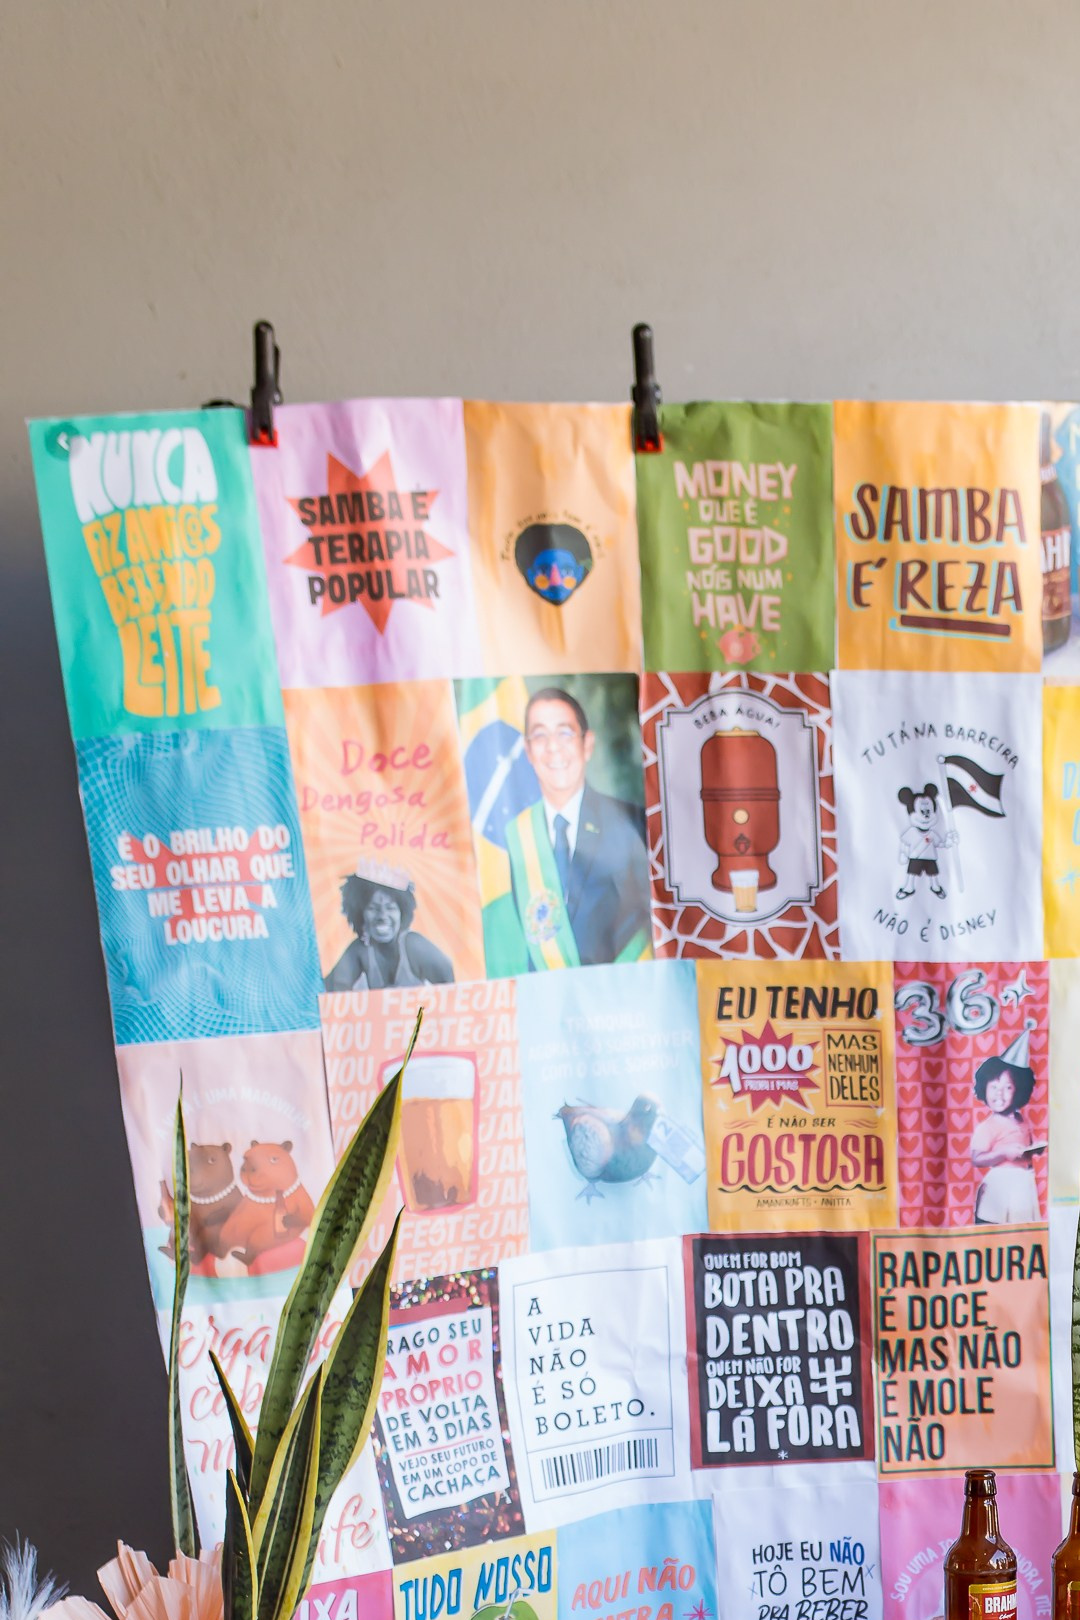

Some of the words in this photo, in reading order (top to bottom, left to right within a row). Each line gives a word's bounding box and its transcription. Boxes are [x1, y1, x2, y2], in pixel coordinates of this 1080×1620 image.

[70, 429, 218, 523] NUNCA
[300, 494, 400, 526] SAMBA
[414, 485, 429, 520] É
[850, 482, 1027, 544] SAMBA
[308, 532, 429, 566] TERAPIA
[308, 570, 439, 605] POPULAR
[900, 561, 1023, 615] REZA
[120, 612, 221, 718] LEITE
[878, 1244, 1046, 1289] RAPADURA
[528, 1297, 541, 1316] A
[880, 1286, 896, 1332] É
[908, 1291, 988, 1330] DOCE
[529, 1318, 595, 1345] VIDA
[879, 1335, 949, 1372] MAS
[959, 1326, 1020, 1370] NÃO
[530, 1349, 586, 1375] NÃO
[534, 1381, 546, 1405] É
[562, 1373, 596, 1399] SÓ
[883, 1373, 897, 1417] É
[909, 1377, 994, 1415] MOLE
[536, 1398, 656, 1435] BOLETO.
[883, 1417, 944, 1462] NÃO
[474, 1546, 552, 1610] NOSSO
[572, 1572, 629, 1611] AQUI
[638, 1557, 695, 1594] NÃO
[985, 1592, 1016, 1613] BRAHM
